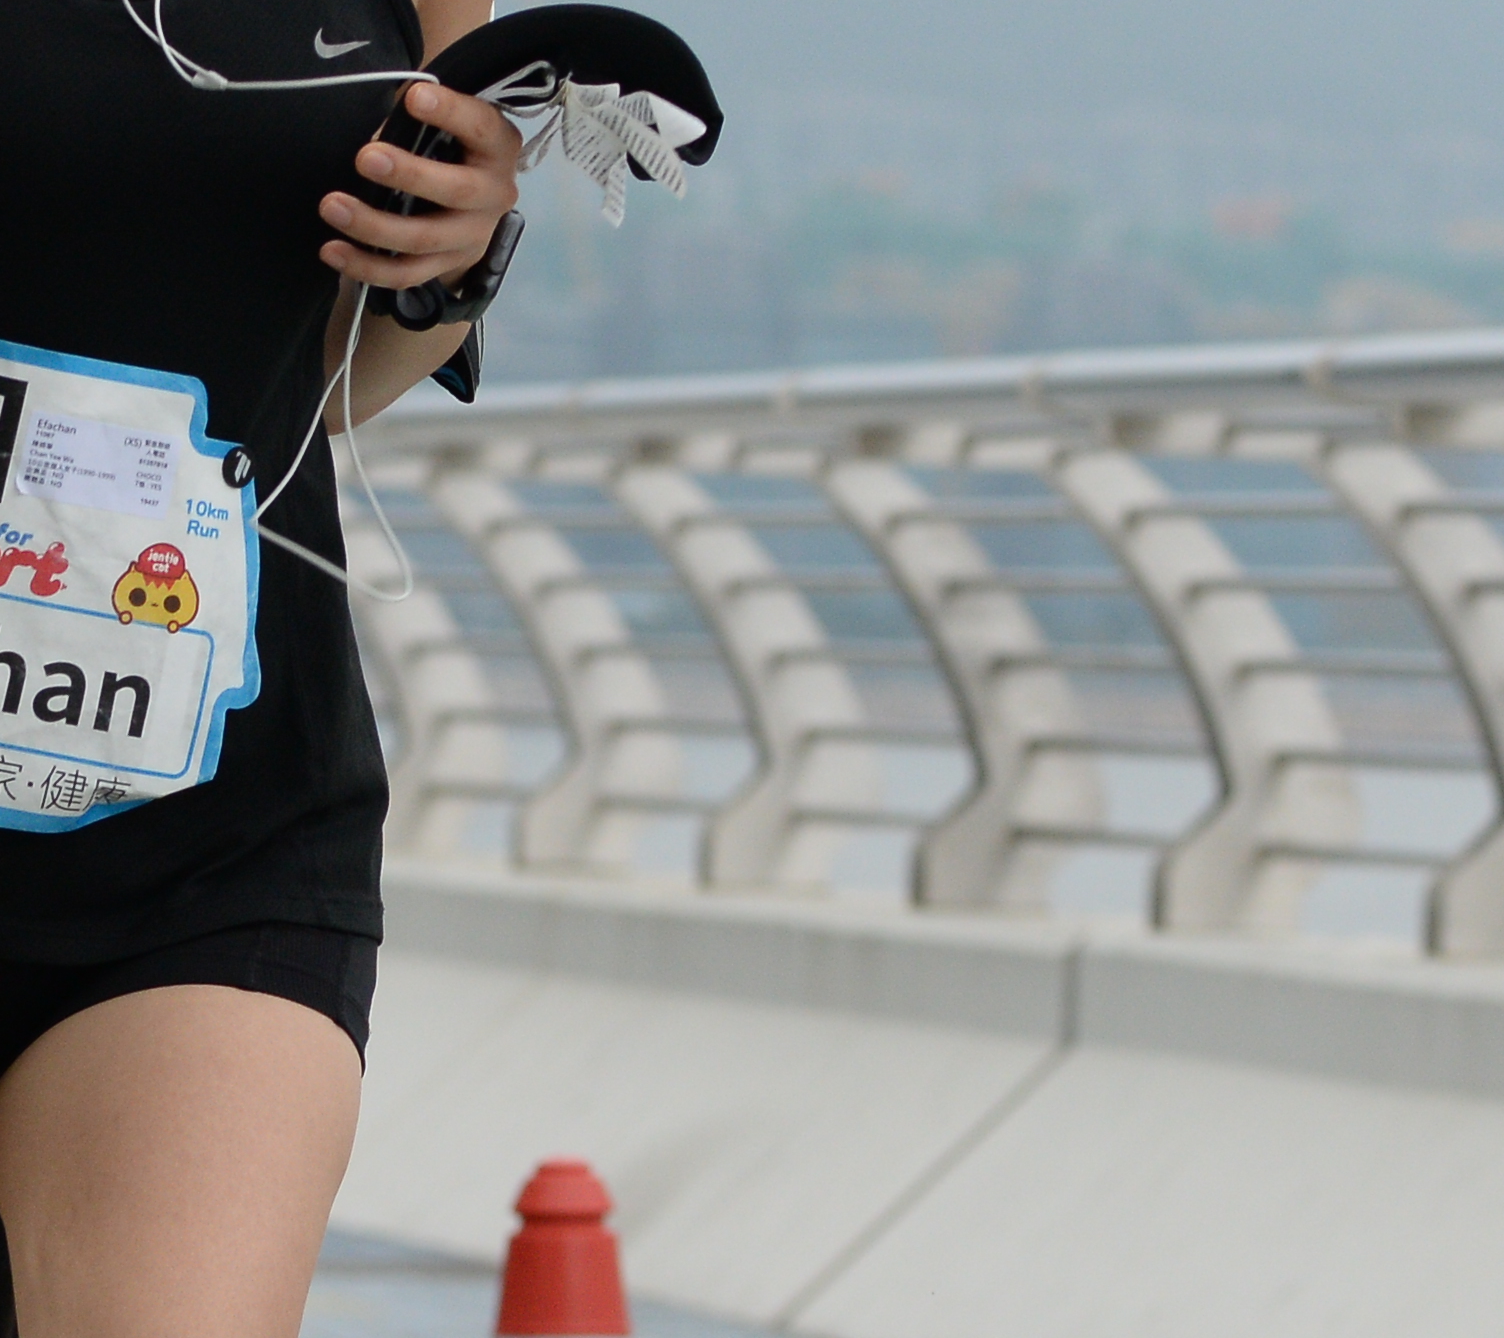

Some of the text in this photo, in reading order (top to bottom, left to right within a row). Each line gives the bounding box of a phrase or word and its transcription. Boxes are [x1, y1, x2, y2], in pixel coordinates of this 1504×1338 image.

[37, 418, 77, 435] Efachan
[186, 498, 229, 521] 10km
[186, 519, 220, 539] Run
